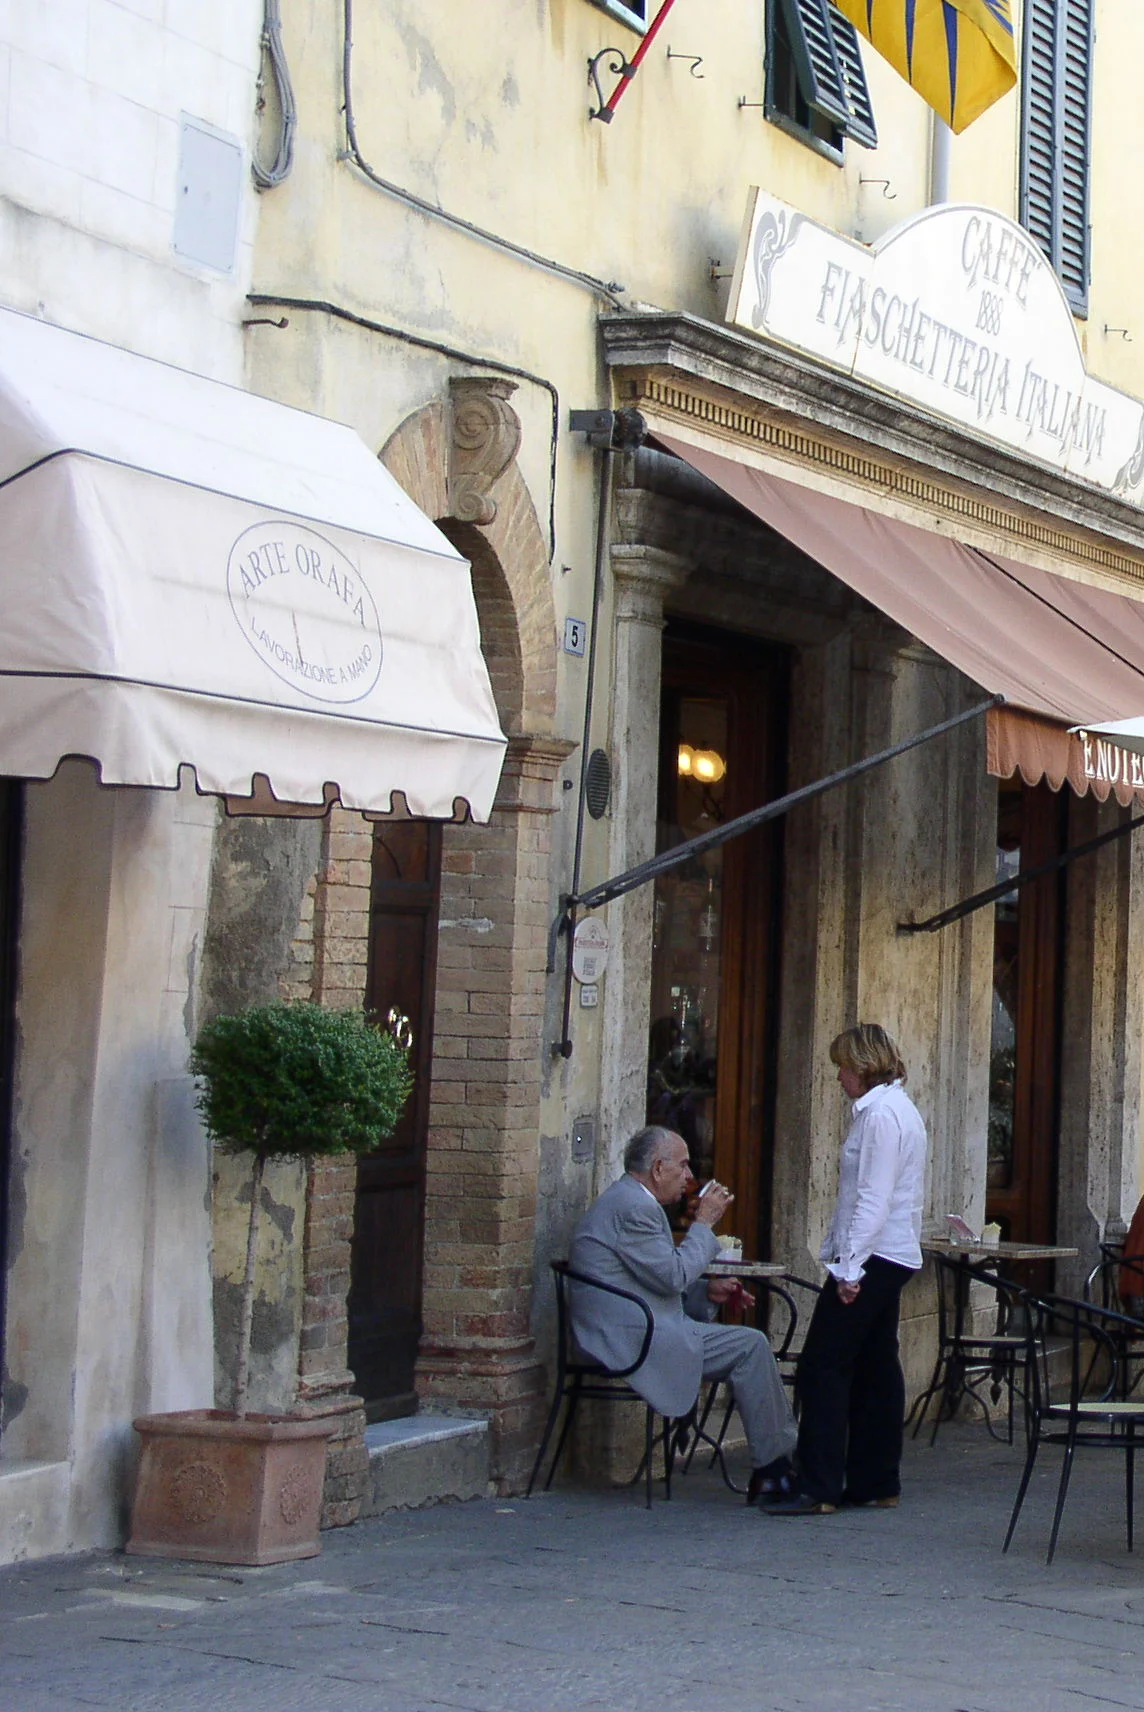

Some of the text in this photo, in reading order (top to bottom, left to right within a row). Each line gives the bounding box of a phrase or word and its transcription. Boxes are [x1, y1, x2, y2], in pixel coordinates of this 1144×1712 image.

[976, 289, 1004, 337] 1888
[815, 260, 1108, 464] FIASCHETTERIA ITALIANA
[239, 541, 367, 630] ARTE ORAFA
[251, 616, 338, 685] LAVORAZIONE
[350, 644, 373, 682] MANO
[571, 625, 579, 648] 5
